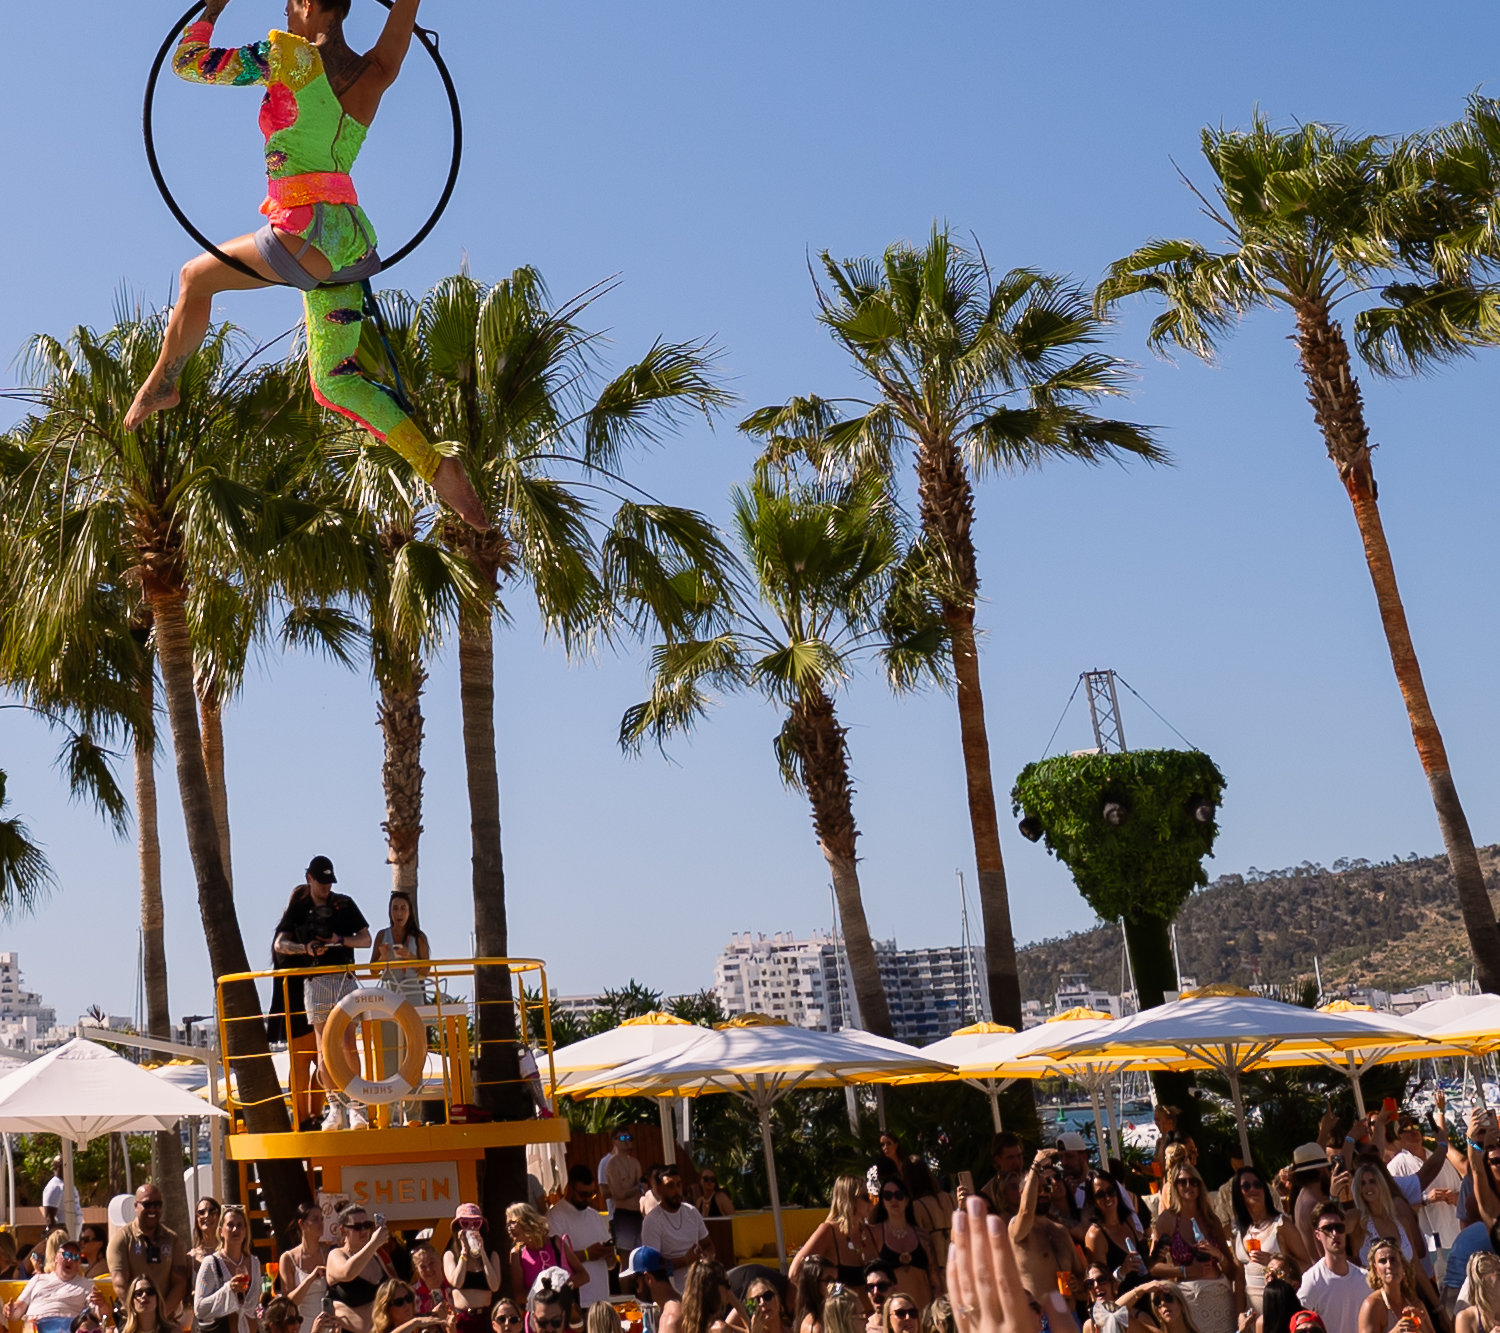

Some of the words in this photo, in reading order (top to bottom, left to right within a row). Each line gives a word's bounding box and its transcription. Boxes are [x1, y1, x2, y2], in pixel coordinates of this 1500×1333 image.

[354, 995, 385, 1004] SHEIN
[362, 1085, 394, 1095] SHEIN
[353, 1177, 450, 1205] SHEIN
